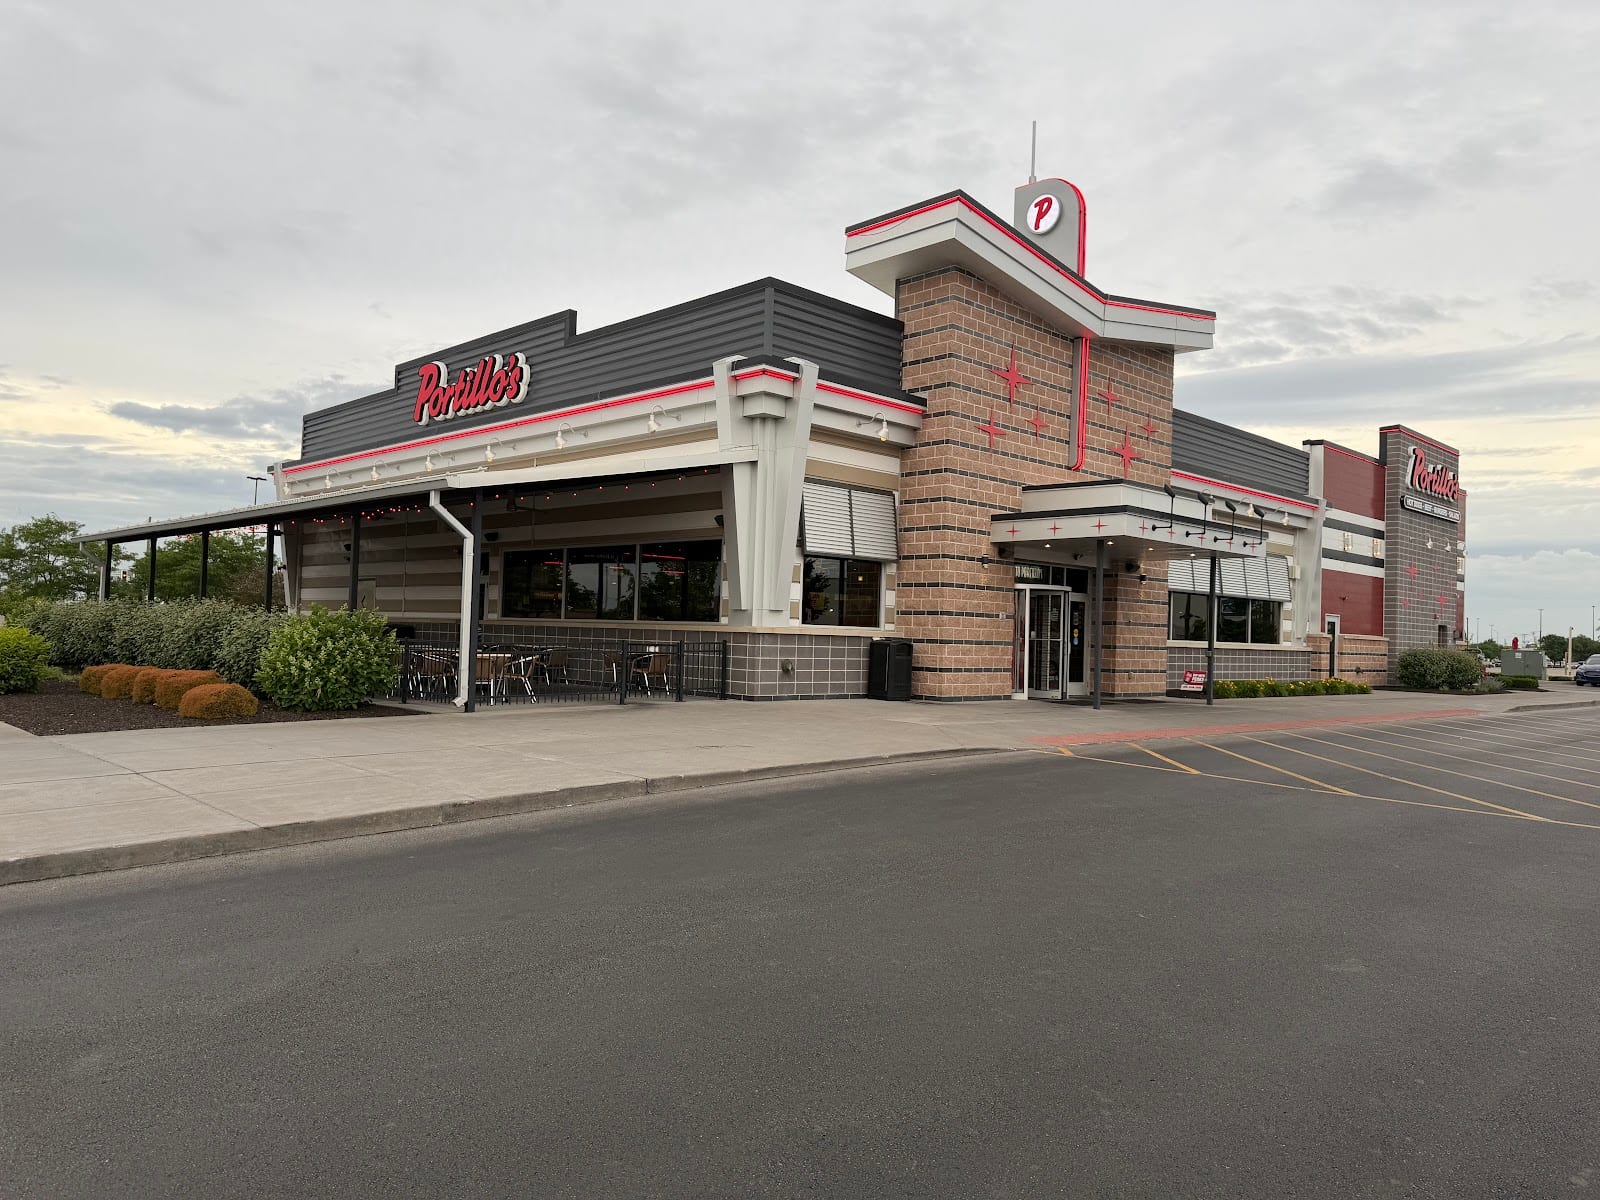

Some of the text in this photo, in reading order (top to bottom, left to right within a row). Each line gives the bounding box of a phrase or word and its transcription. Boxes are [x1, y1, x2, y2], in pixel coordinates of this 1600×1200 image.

[1034, 196, 1053, 231] P
[413, 352, 528, 425] Portillo's
[1406, 446, 1460, 501] Portillo's
